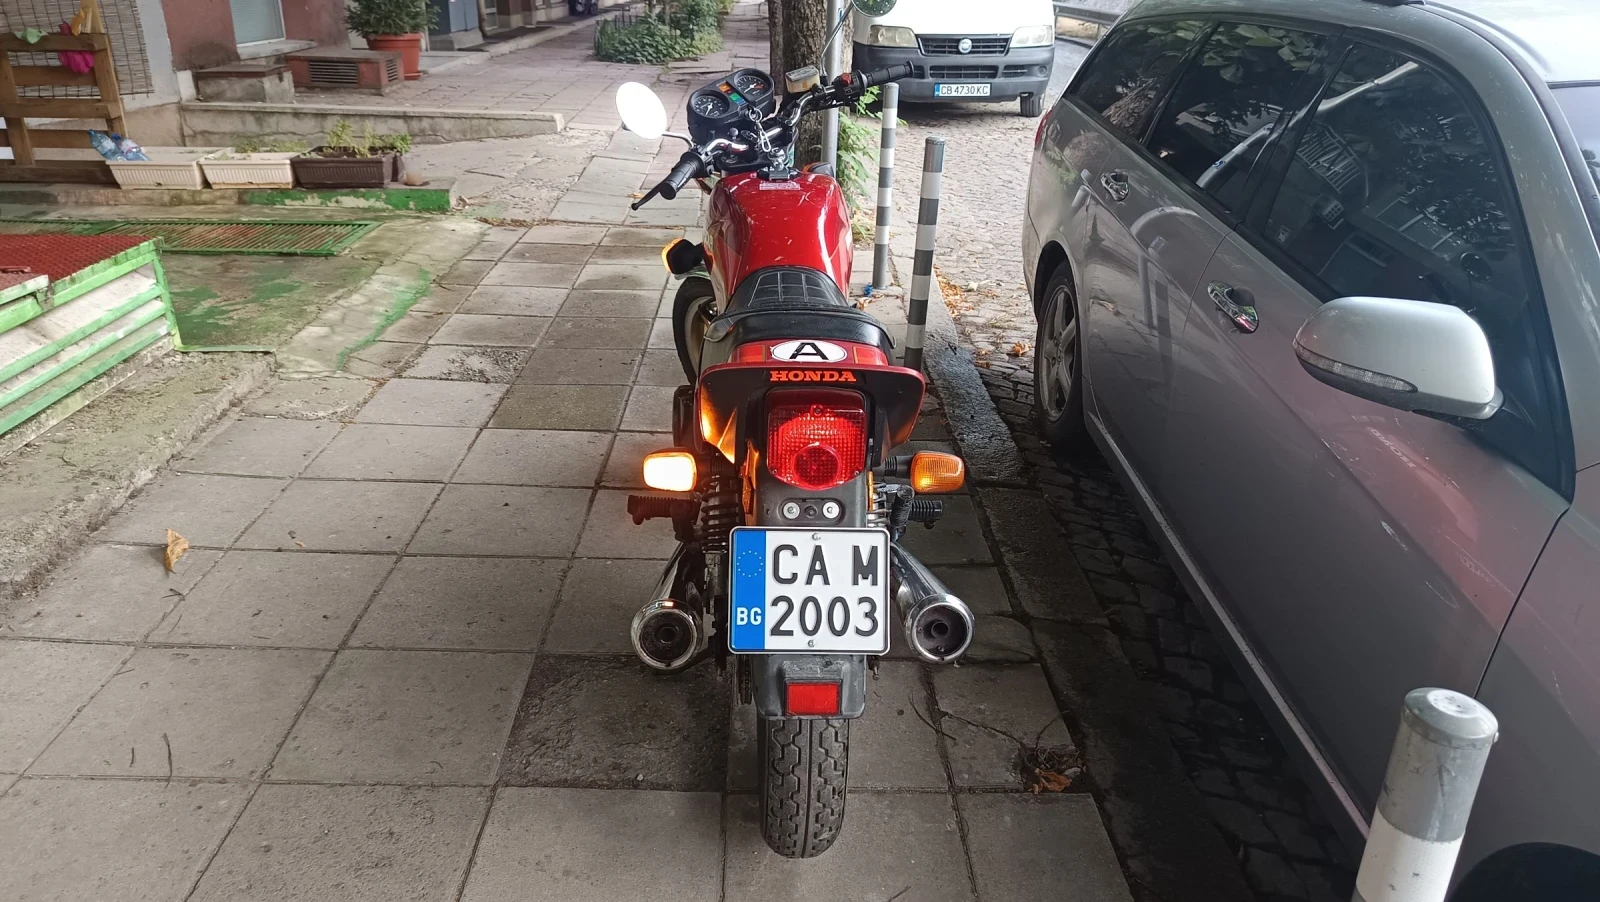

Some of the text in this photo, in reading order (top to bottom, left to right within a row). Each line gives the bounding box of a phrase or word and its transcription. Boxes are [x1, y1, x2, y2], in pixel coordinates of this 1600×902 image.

[941, 86, 952, 94] CB
[954, 86, 975, 94] 4730
[976, 86, 988, 94] KC
[789, 342, 829, 360] A
[769, 370, 857, 382] HONDA
[772, 544, 879, 586] CA M
[736, 607, 762, 626] BG
[770, 595, 879, 637] 2003
